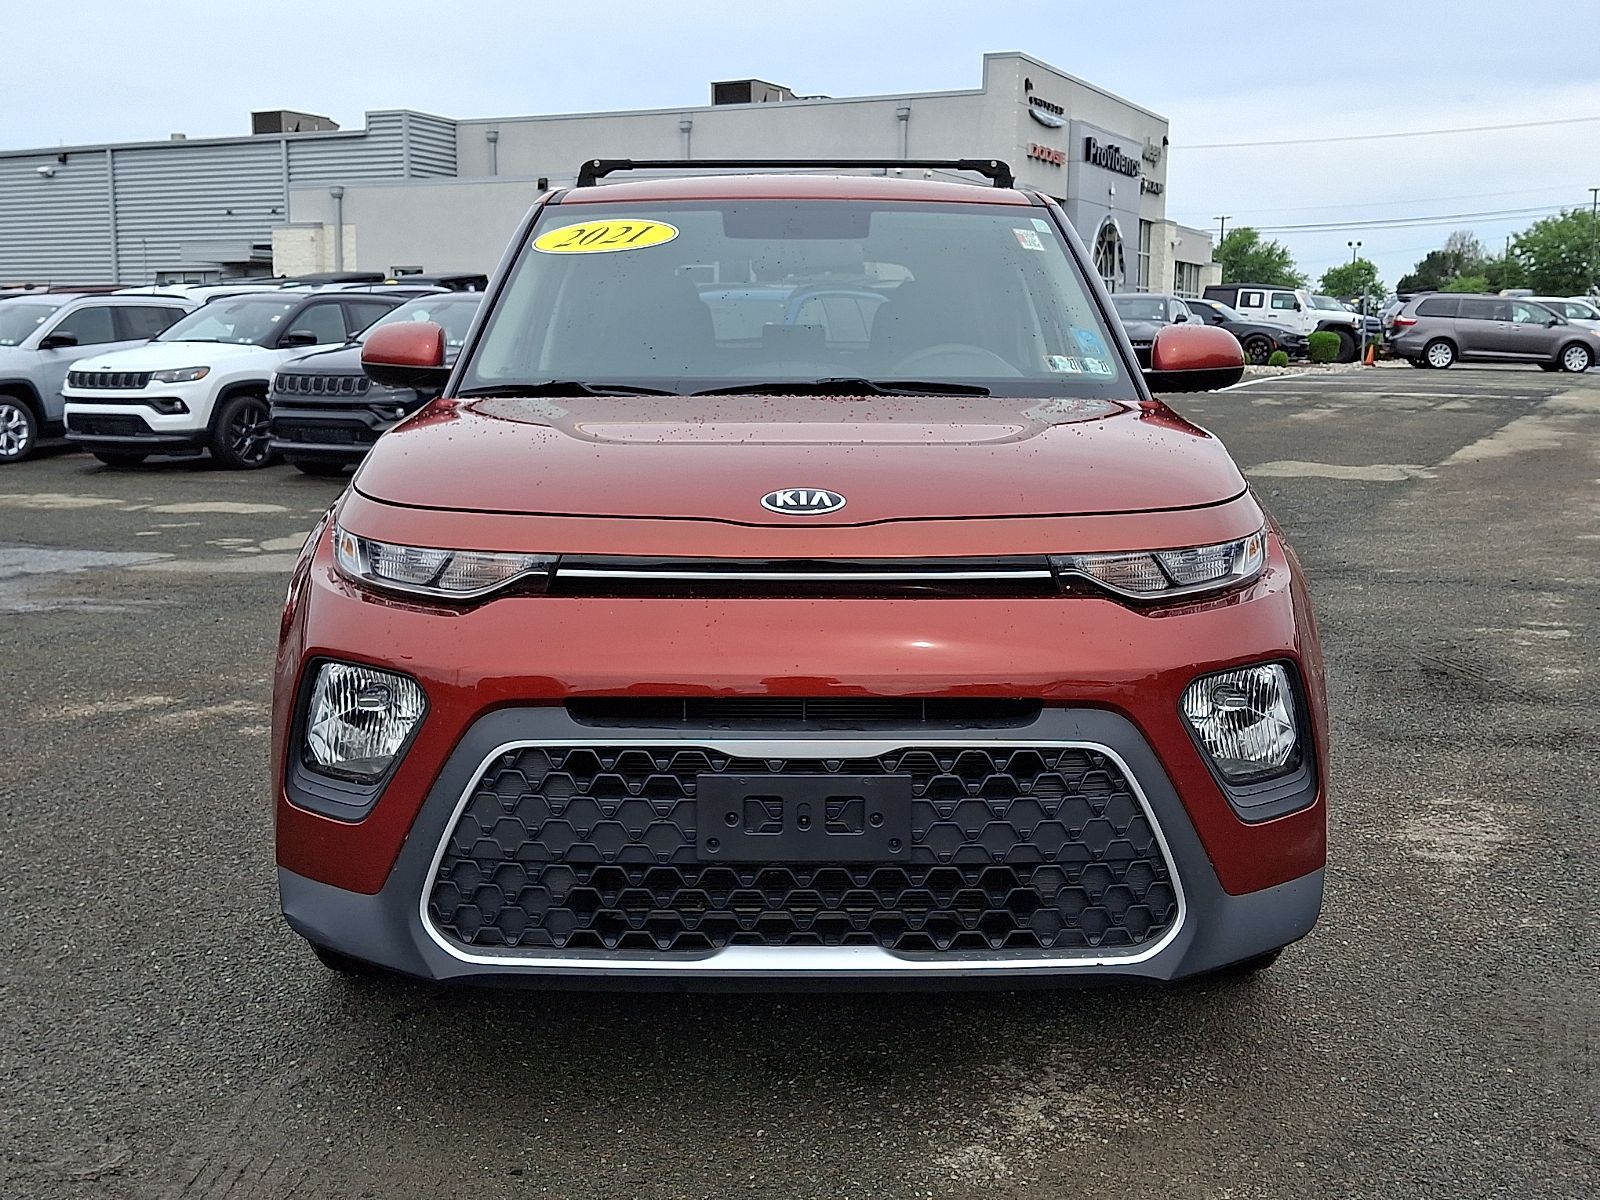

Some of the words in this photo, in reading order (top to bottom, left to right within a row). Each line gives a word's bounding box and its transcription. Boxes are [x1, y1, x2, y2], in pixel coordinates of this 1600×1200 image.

[1085, 136, 1141, 177] Providence
[552, 225, 654, 249] 2021
[776, 490, 832, 507] KIA
